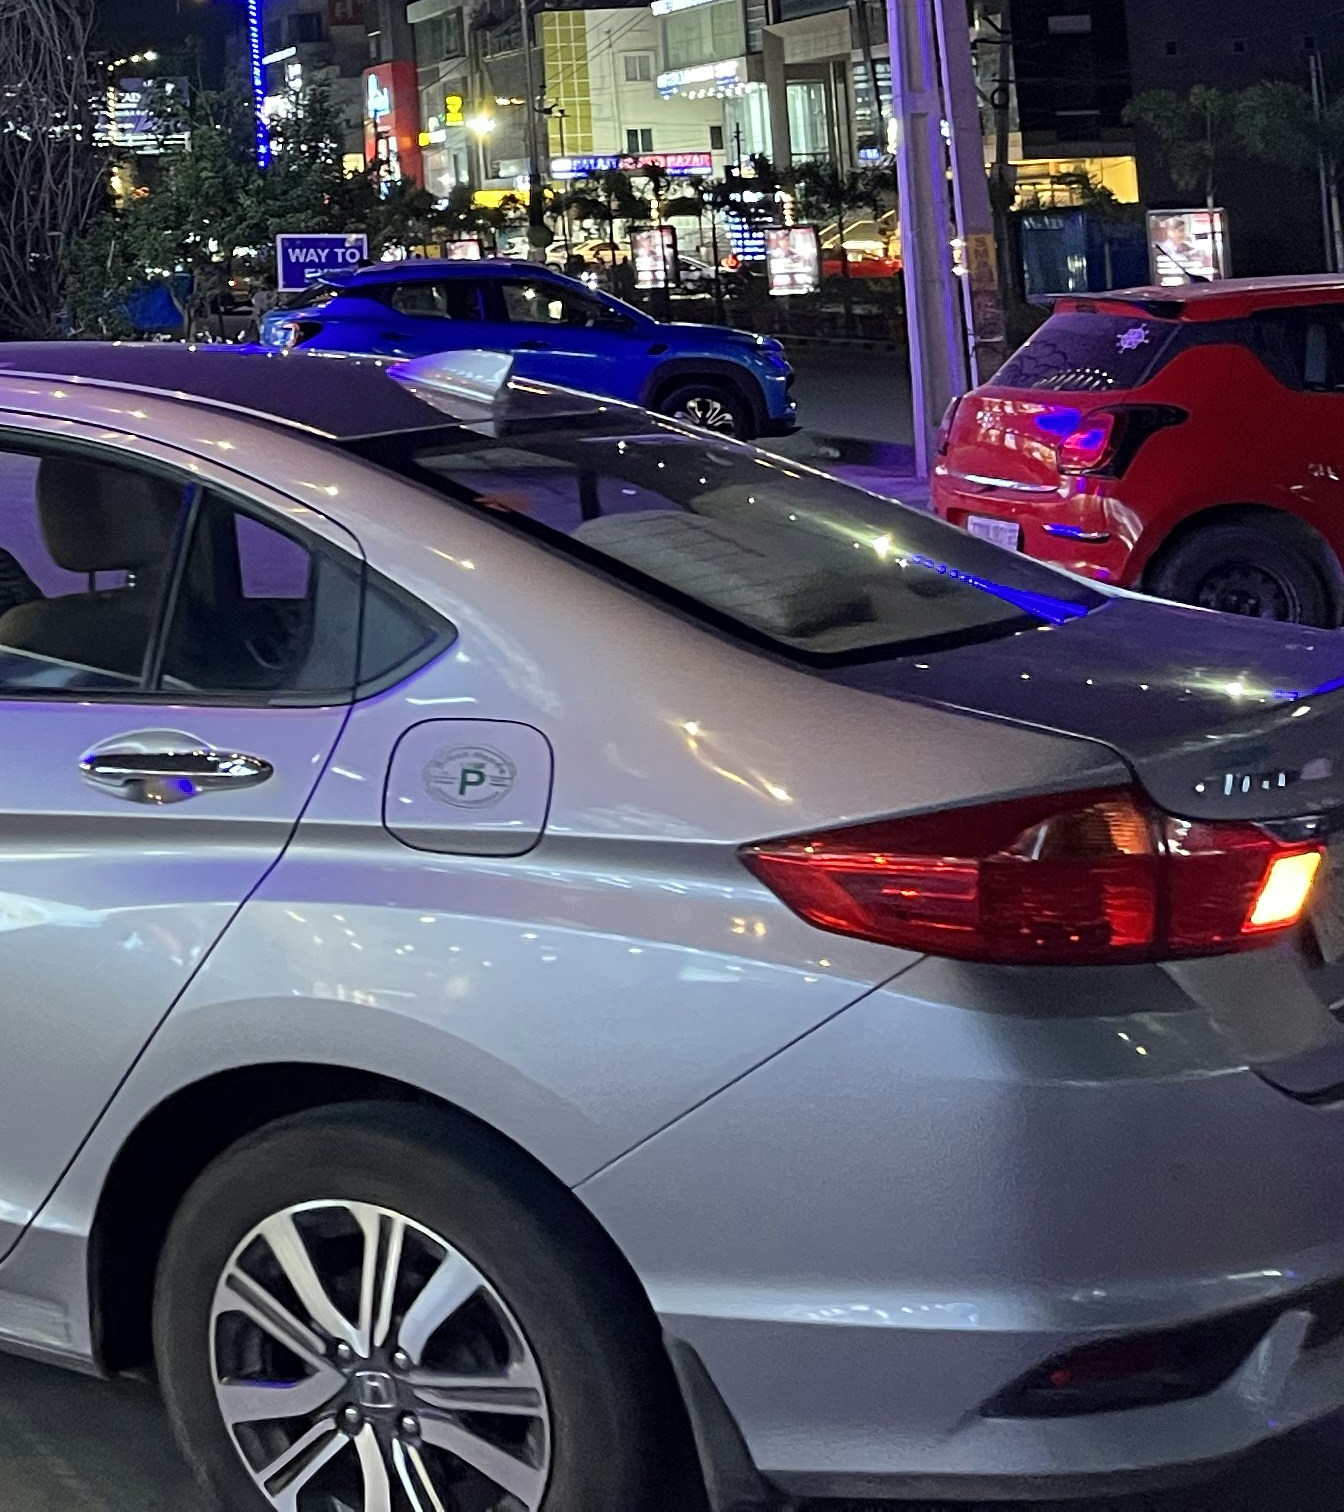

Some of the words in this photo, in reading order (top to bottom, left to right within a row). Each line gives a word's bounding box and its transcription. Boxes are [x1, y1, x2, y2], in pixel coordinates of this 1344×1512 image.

[287, 248, 330, 263] WAY
[333, 248, 360, 263] TO
[458, 768, 486, 796] P
